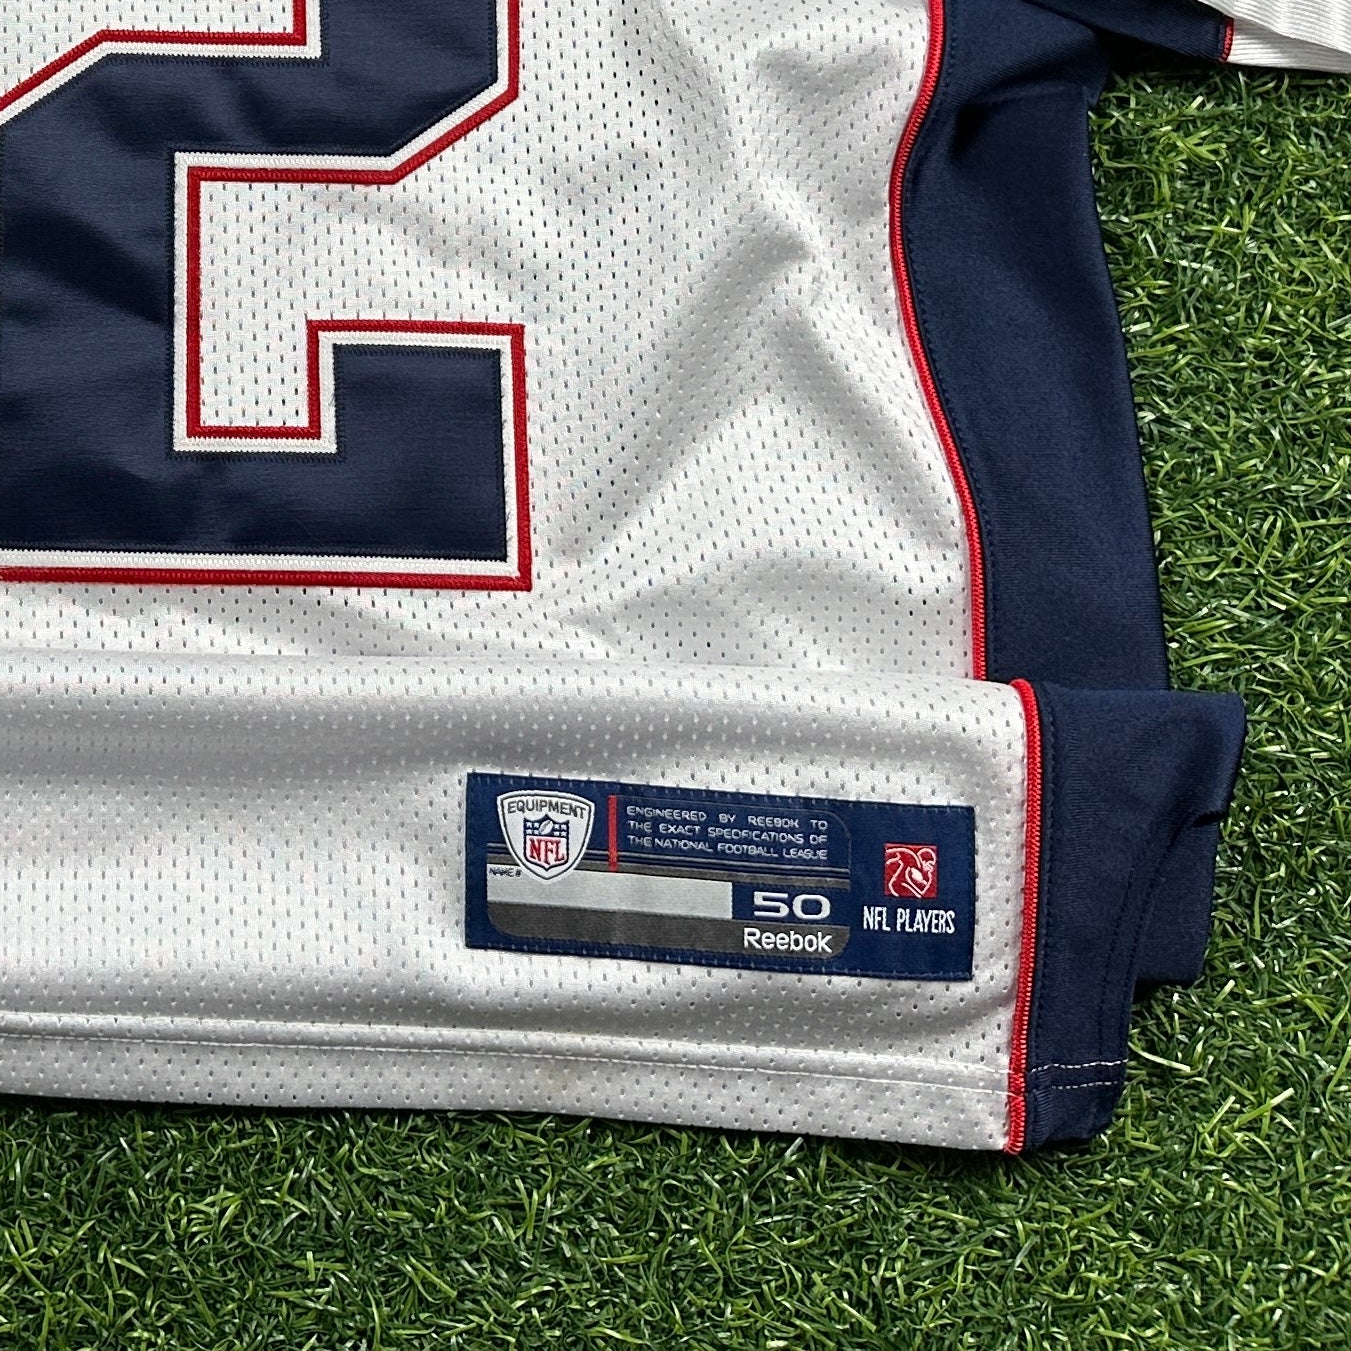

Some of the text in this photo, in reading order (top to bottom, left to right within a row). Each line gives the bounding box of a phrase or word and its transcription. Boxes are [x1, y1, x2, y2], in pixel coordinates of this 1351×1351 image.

[508, 799, 586, 819] EQUIPMENT
[626, 805, 828, 830] ENGINEERED BY REEBOK TO
[628, 820, 652, 833] THE
[659, 823, 700, 836] EXACT
[809, 834, 828, 845] OF
[529, 837, 565, 866] NFL
[627, 835, 828, 860] THE NATIONAL FOOTBALL LEAGUE
[753, 891, 831, 920] 50
[863, 905, 956, 934] NFL PLAYERS
[743, 927, 833, 953] Reebok
